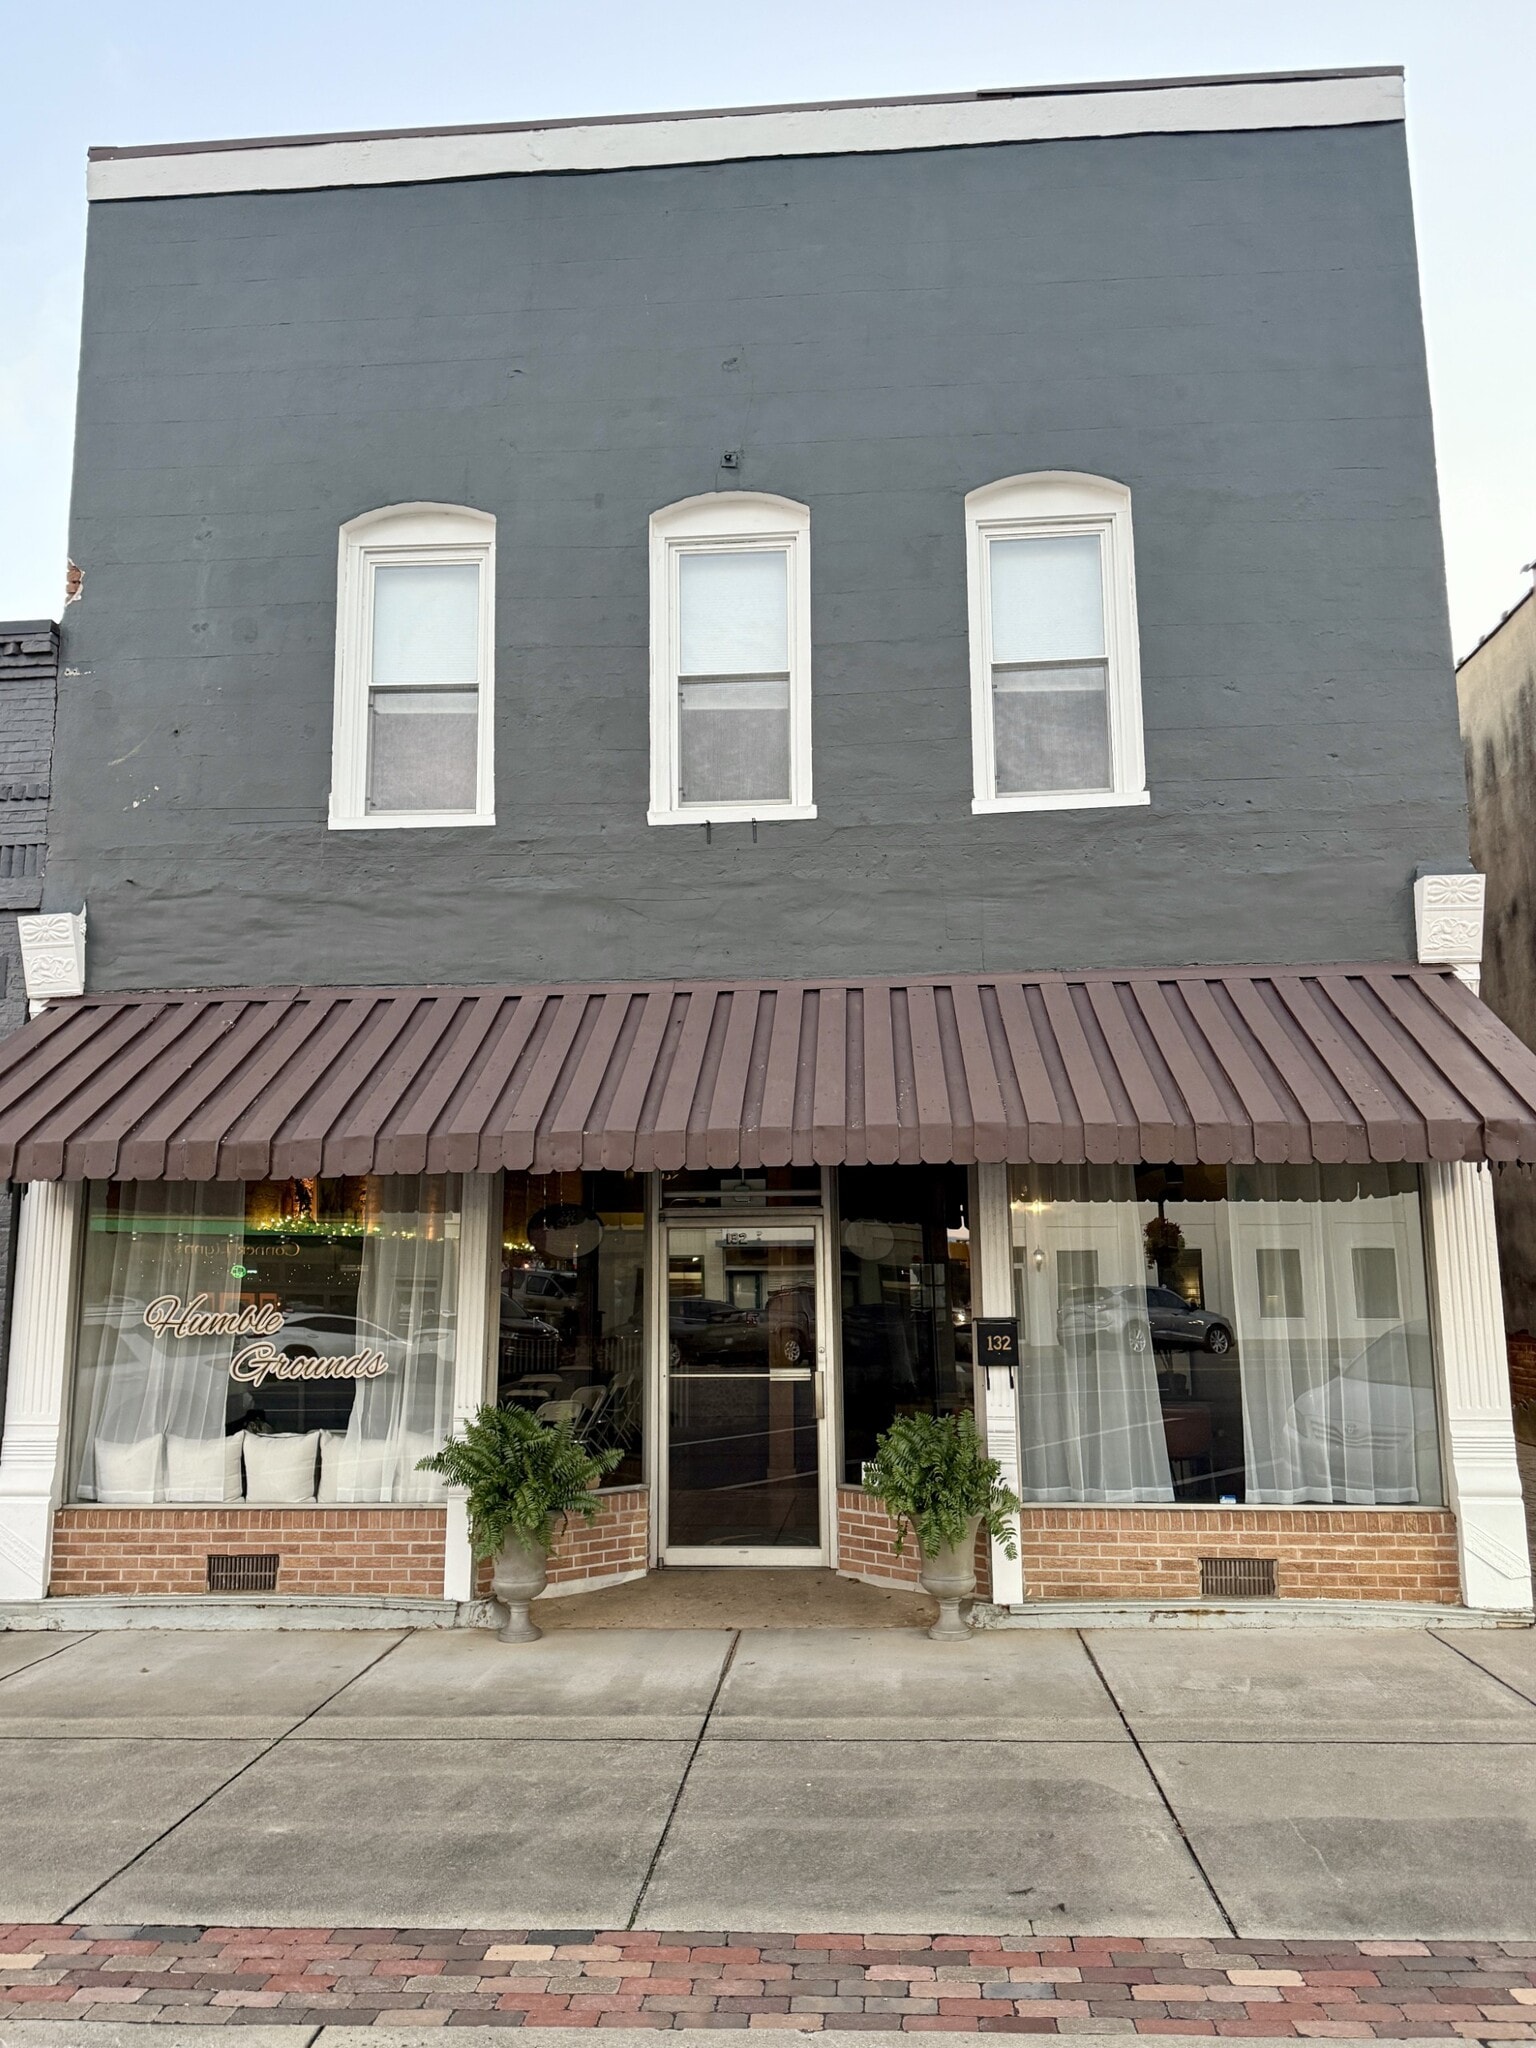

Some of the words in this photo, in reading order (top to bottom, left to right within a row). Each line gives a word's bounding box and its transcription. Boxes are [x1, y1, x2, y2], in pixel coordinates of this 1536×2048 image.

[144, 1293, 285, 1338] Humble
[229, 1341, 388, 1387] Grounds
[987, 1335, 1012, 1351] 132
